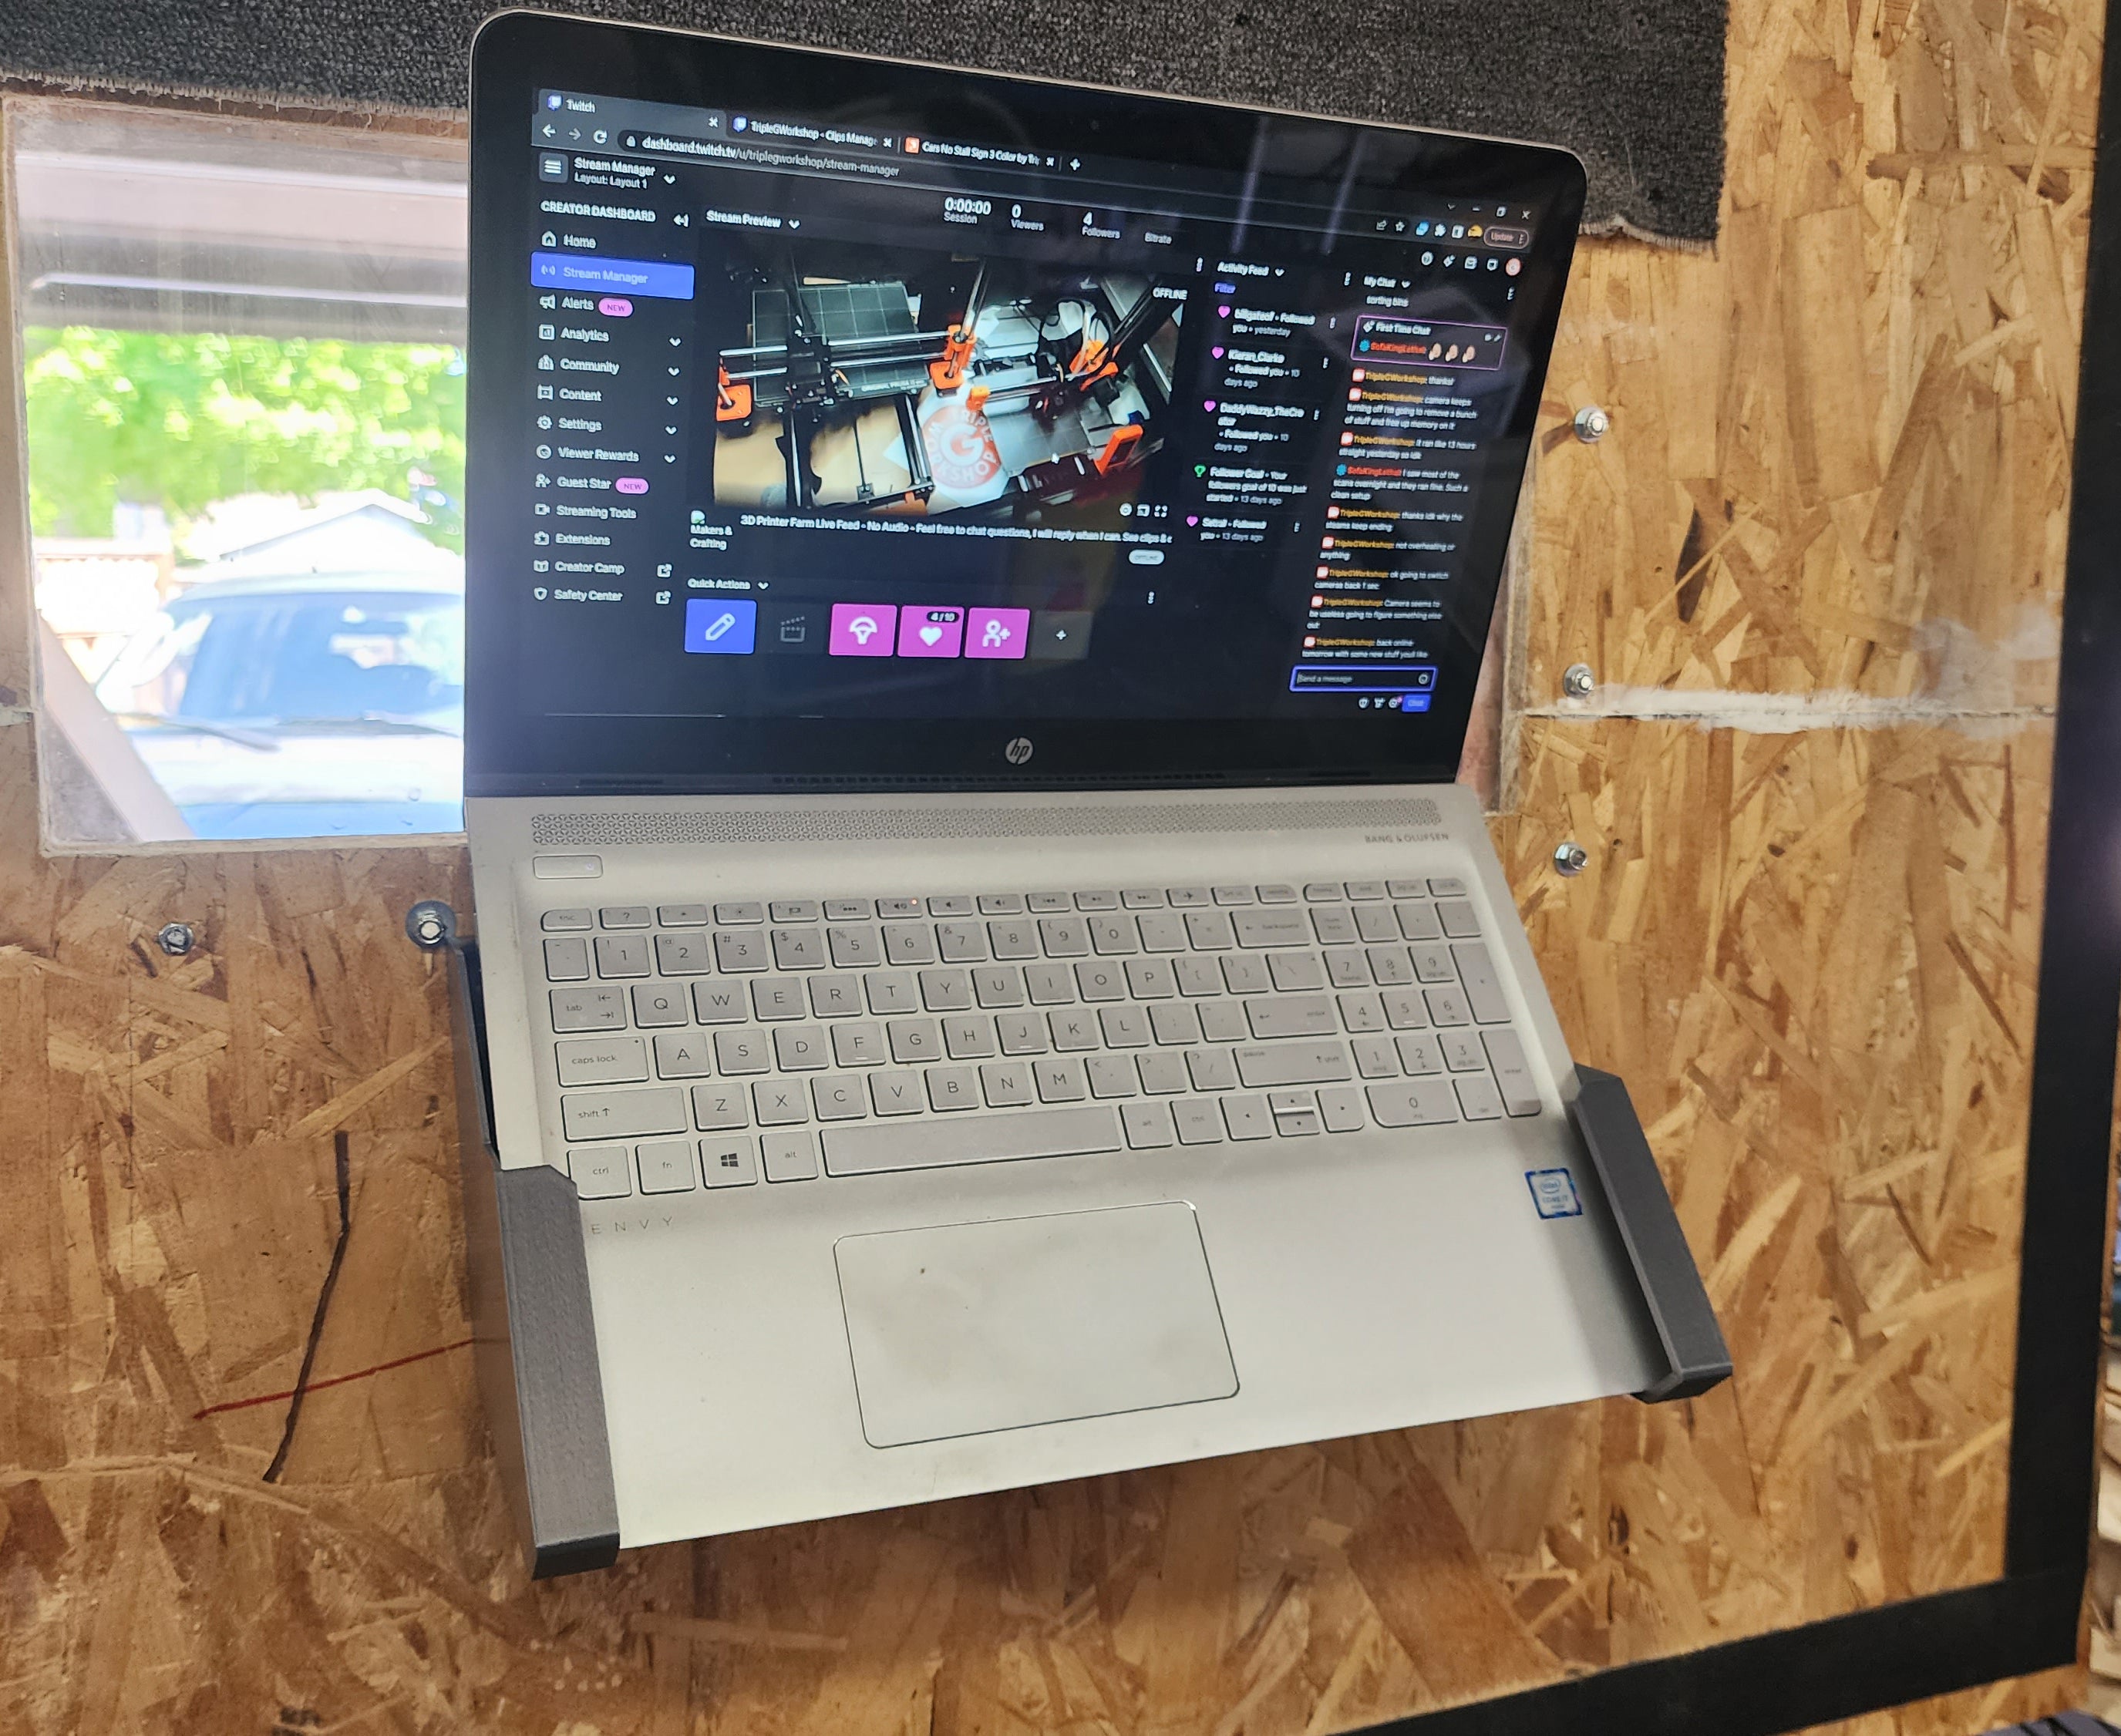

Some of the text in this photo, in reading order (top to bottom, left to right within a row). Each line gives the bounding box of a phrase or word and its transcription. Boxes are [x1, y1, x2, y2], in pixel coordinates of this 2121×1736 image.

[566, 98, 595, 113] Twitch
[941, 143, 953, 155] No
[971, 147, 988, 160] Sign
[989, 150, 995, 160] 3
[574, 157, 655, 177] Stream Manager
[574, 172, 647, 188] Layout: Layout 1
[540, 200, 656, 223] CREATOR DASHBOARD
[945, 197, 991, 215] 0:00:00
[1012, 204, 1022, 218] 0
[706, 210, 781, 229] Stream Preview
[944, 212, 978, 224] Session
[1083, 212, 1092, 226] 4
[1011, 220, 1044, 231] Viewers
[1082, 227, 1120, 239] Followers
[1145, 233, 1172, 245] Bitrate
[563, 234, 596, 249] Home
[563, 267, 648, 285] Stream Manager
[1248, 264, 1269, 276] Feed
[1153, 288, 1188, 300] OFFLINE
[561, 297, 594, 311] Alerts
[561, 327, 609, 342] Analytics
[560, 358, 619, 375] Community
[559, 389, 602, 402] Content
[558, 418, 602, 432] Settings
[557, 446, 640, 462] Viewer Rewards
[557, 476, 611, 490] Guest Star
[556, 505, 637, 520] Streaming Tools
[691, 524, 724, 536] Makers
[740, 514, 756, 526] 3D
[756, 516, 789, 528] Printer
[789, 517, 815, 529] Farm
[816, 519, 835, 530] Live
[837, 520, 860, 530] Feed
[867, 521, 881, 532] No
[882, 522, 909, 533] Audio
[916, 523, 935, 534] Feel
[937, 523, 954, 534] free
[955, 526, 965, 535] to
[966, 526, 986, 536] chat
[555, 533, 611, 546] Extensions
[689, 538, 727, 551] Crafting
[555, 561, 625, 575] Creator Camp
[688, 579, 751, 590] Quick Actions
[554, 589, 623, 602] Safety Center
[1008, 933, 1018, 944] 8
[1059, 930, 1069, 942] 9
[1108, 928, 1119, 940] 0
[794, 941, 805, 954] 4
[851, 939, 860, 951] 5
[904, 937, 915, 949] 6
[957, 935, 967, 947] 7
[621, 949, 628, 961] 1
[678, 947, 689, 959] 2
[738, 944, 748, 957] 3
[1344, 961, 1350, 972] 7
[1047, 977, 1053, 988] I
[1094, 973, 1108, 986] O
[1144, 971, 1155, 983] P
[885, 985, 897, 998] T
[939, 981, 951, 994] Y
[992, 979, 1005, 992] U
[711, 994, 731, 1007] W
[773, 991, 785, 1004] E
[830, 987, 842, 1001] R
[565, 1004, 583, 1013] tab
[653, 997, 669, 1011] Q
[1401, 1003, 1410, 1014] 5
[1443, 1000, 1453, 1011] 6
[1358, 1006, 1367, 1017] 4
[1019, 1025, 1028, 1038] J
[1068, 1022, 1080, 1035] K
[1120, 1020, 1130, 1031] L
[908, 1032, 922, 1046] G
[963, 1029, 976, 1041] H
[796, 1040, 810, 1054] D
[854, 1035, 865, 1049] F
[676, 1047, 692, 1061] A
[737, 1044, 749, 1057] S
[1373, 1051, 1380, 1062] 1
[1415, 1048, 1425, 1059] 2
[1457, 1045, 1467, 1056] 3
[571, 1054, 617, 1065] caps lock
[1001, 1077, 1014, 1090] N
[1052, 1073, 1067, 1085] M
[890, 1085, 904, 1098] V
[947, 1081, 960, 1094] B
[775, 1094, 789, 1108] X
[833, 1089, 847, 1103] C
[1409, 1096, 1419, 1109] 0
[715, 1098, 729, 1112] Z
[577, 1108, 600, 1119] shift
[784, 1149, 797, 1159] alt
[592, 1166, 609, 1176] ctrl
[661, 1160, 673, 1170] fn
[591, 1216, 673, 1235] ENVY
